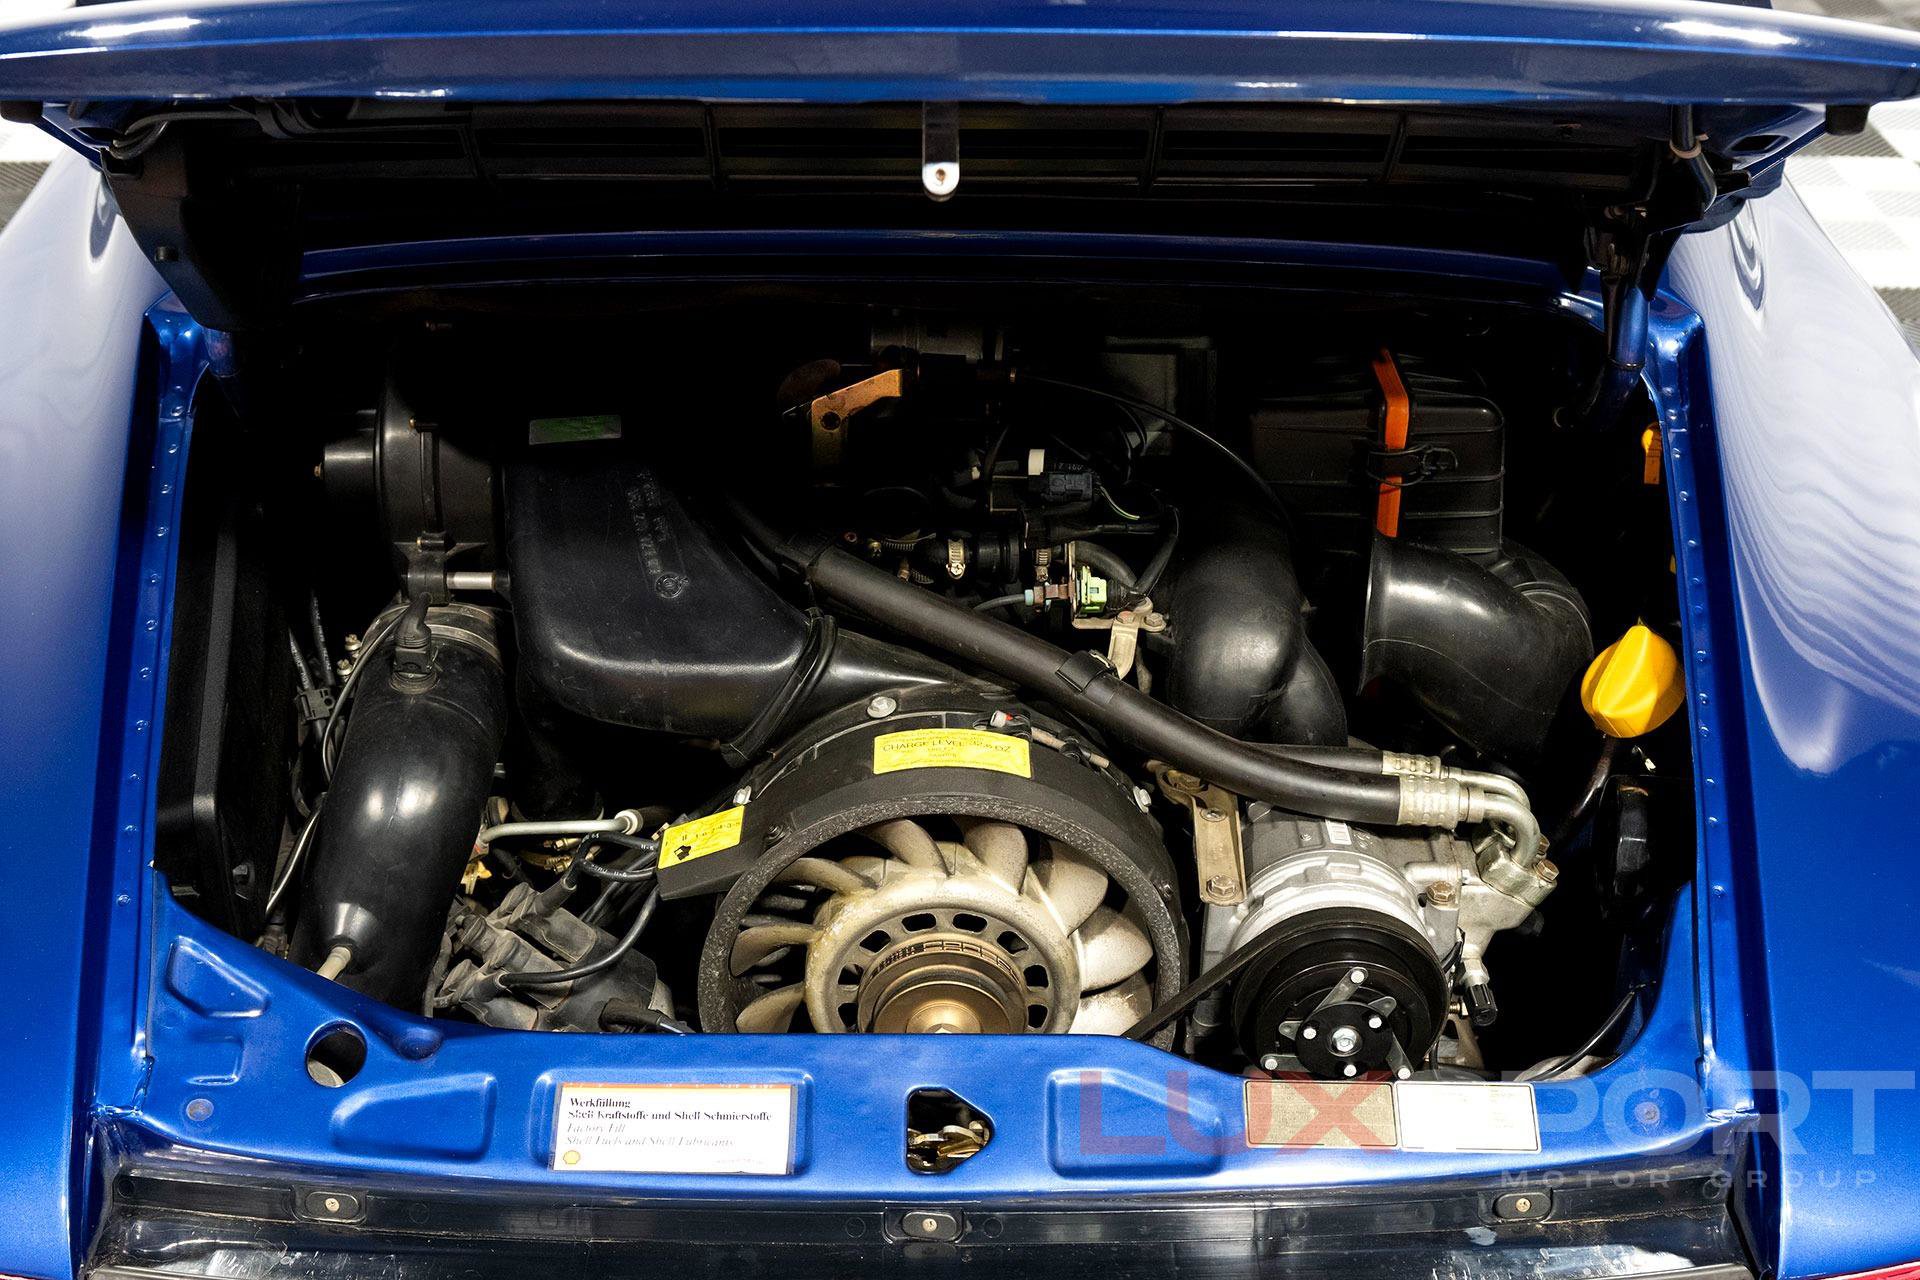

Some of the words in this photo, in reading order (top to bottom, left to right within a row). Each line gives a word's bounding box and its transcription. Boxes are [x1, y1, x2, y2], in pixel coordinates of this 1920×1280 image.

[883, 741, 928, 752] CHARGE
[570, 1097, 631, 1108] Werkfüllung
[568, 1110, 594, 1119] Shell
[597, 1110, 648, 1120] Kraftstoffe
[652, 1111, 671, 1120] und
[674, 1111, 701, 1121] Shell
[703, 1111, 773, 1121] Schmierstoffe
[567, 1135, 593, 1145] Shell
[624, 1136, 647, 1146] and
